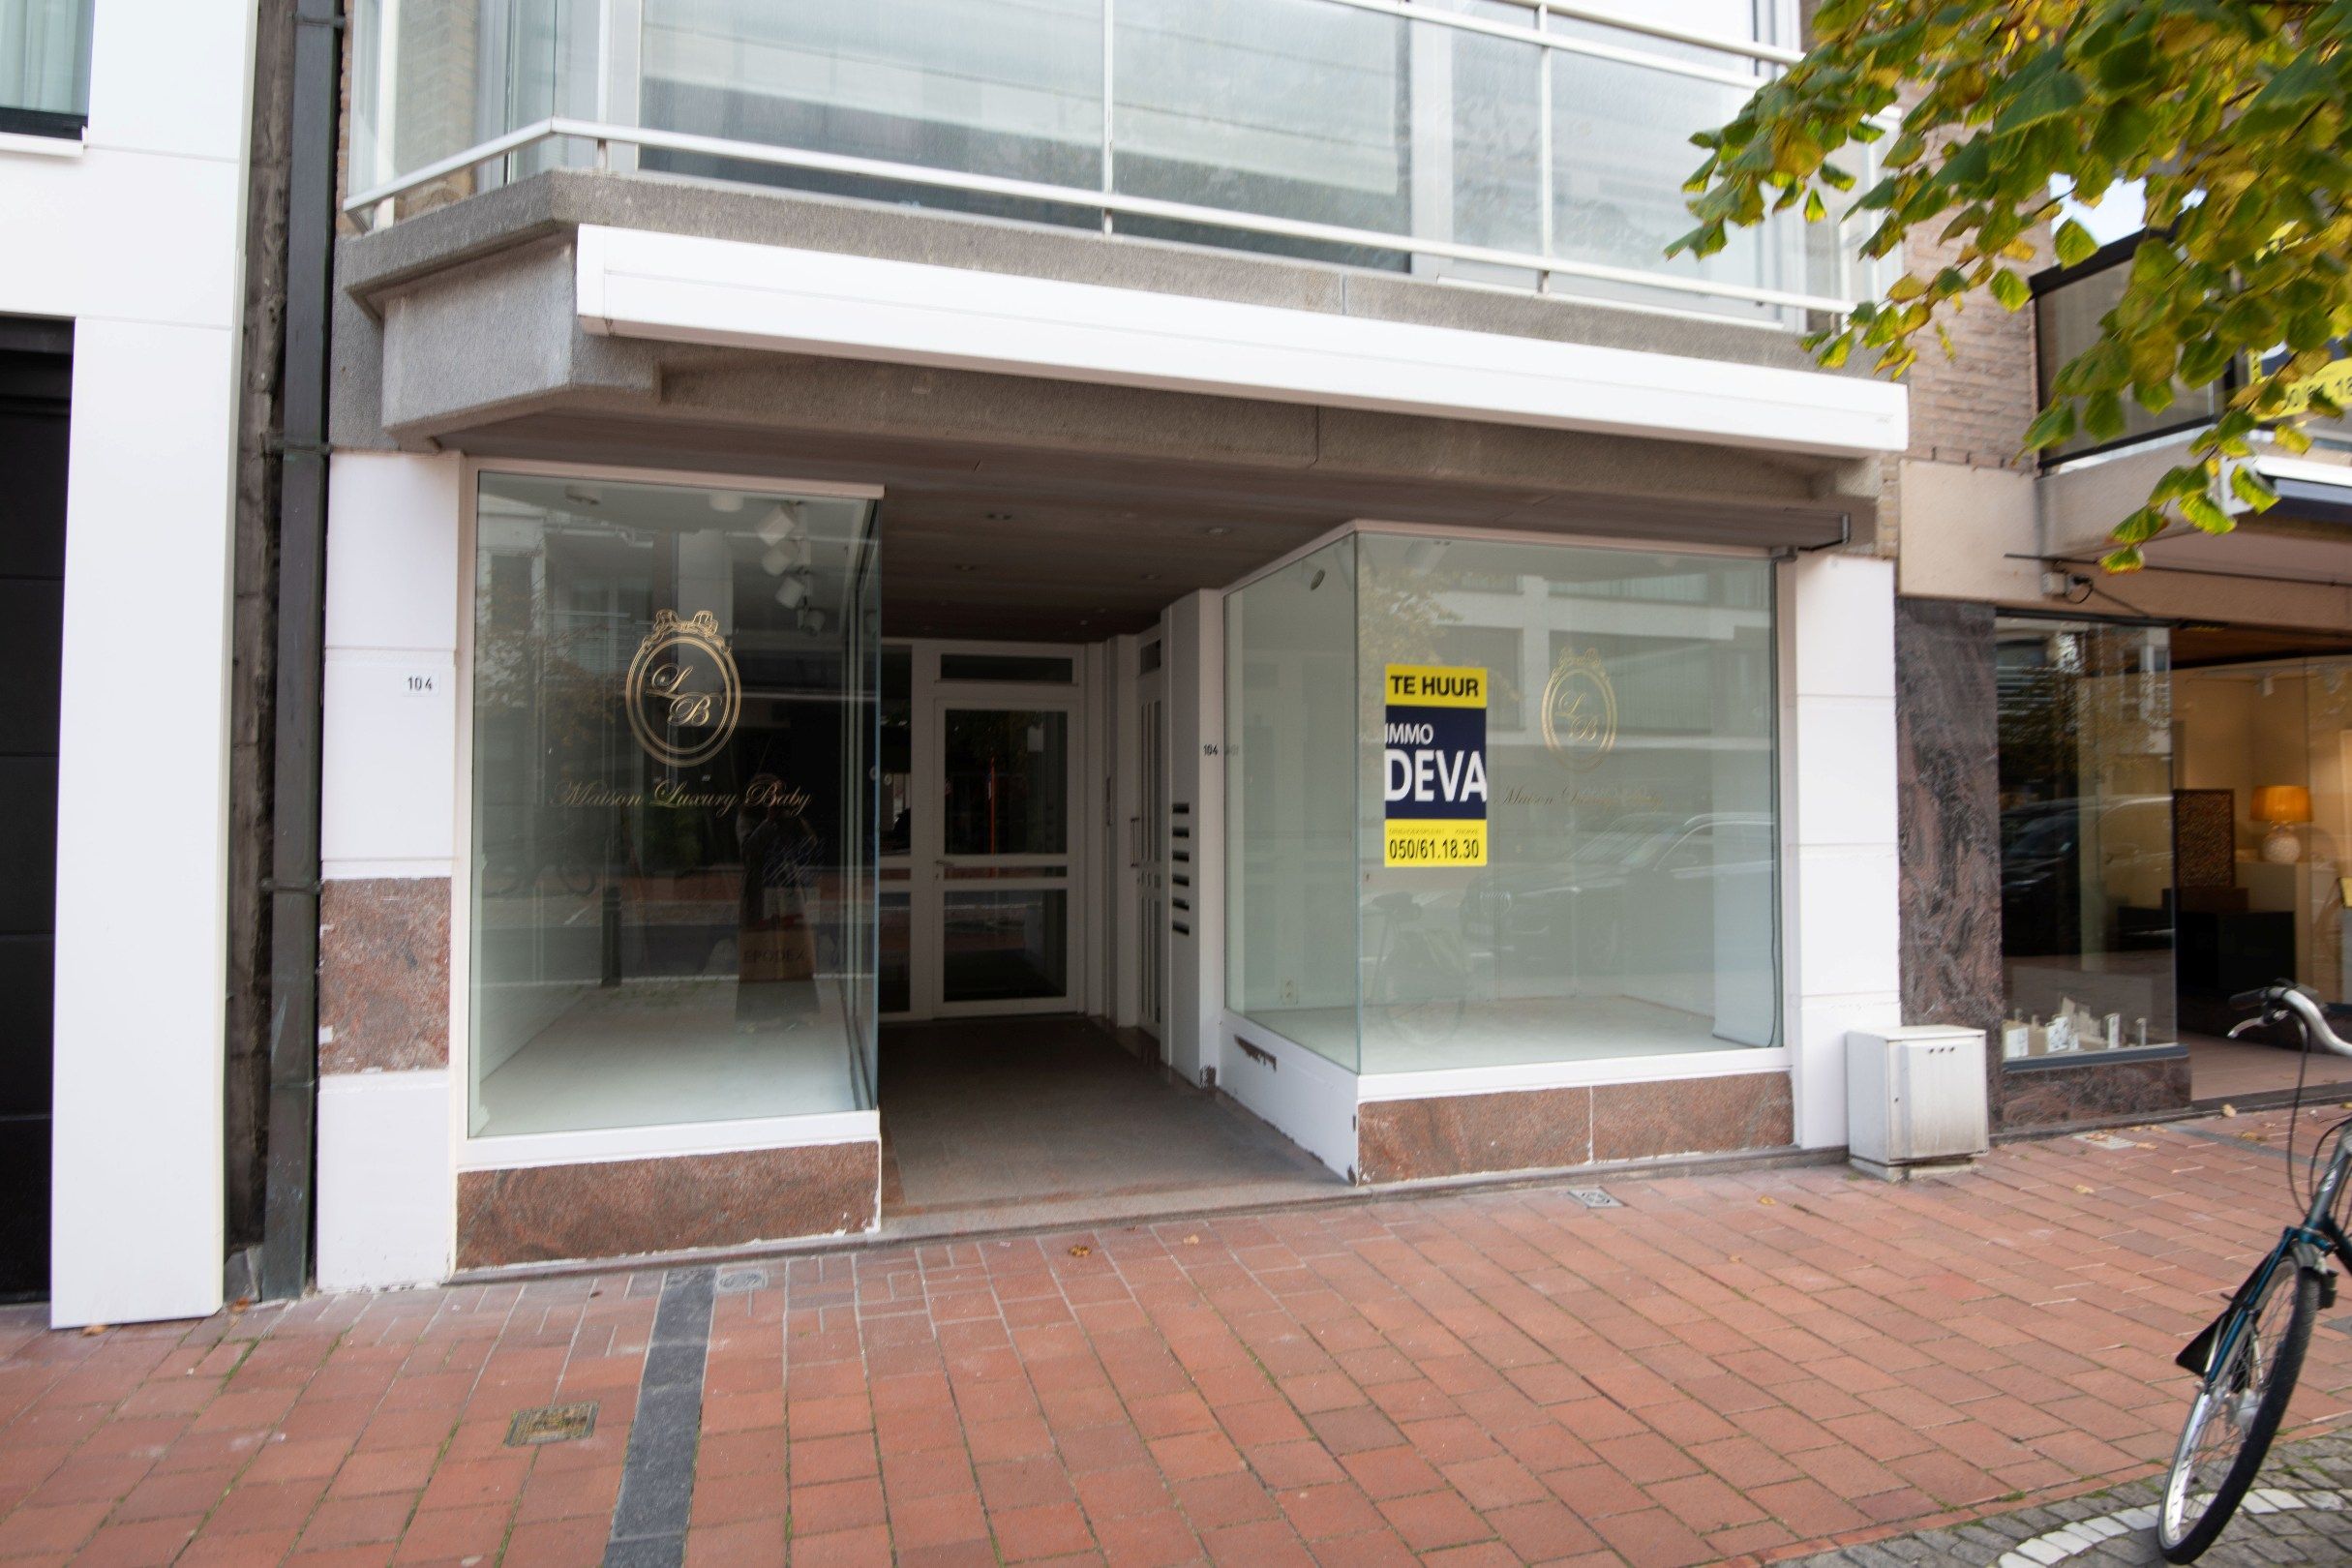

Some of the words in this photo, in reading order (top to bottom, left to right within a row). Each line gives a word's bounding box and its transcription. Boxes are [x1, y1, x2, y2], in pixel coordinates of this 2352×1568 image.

[408, 677, 433, 691] 104
[1390, 676, 1416, 695] TE
[1422, 677, 1479, 697] HUUR
[1384, 723, 1434, 745] IMMO
[1203, 743, 1219, 756] 104
[1384, 749, 1488, 802] DEVA
[551, 780, 645, 807] Maison
[649, 778, 739, 817] Luxury
[744, 776, 812, 817] Baby
[1389, 838, 1479, 859] 050/61.18.30
